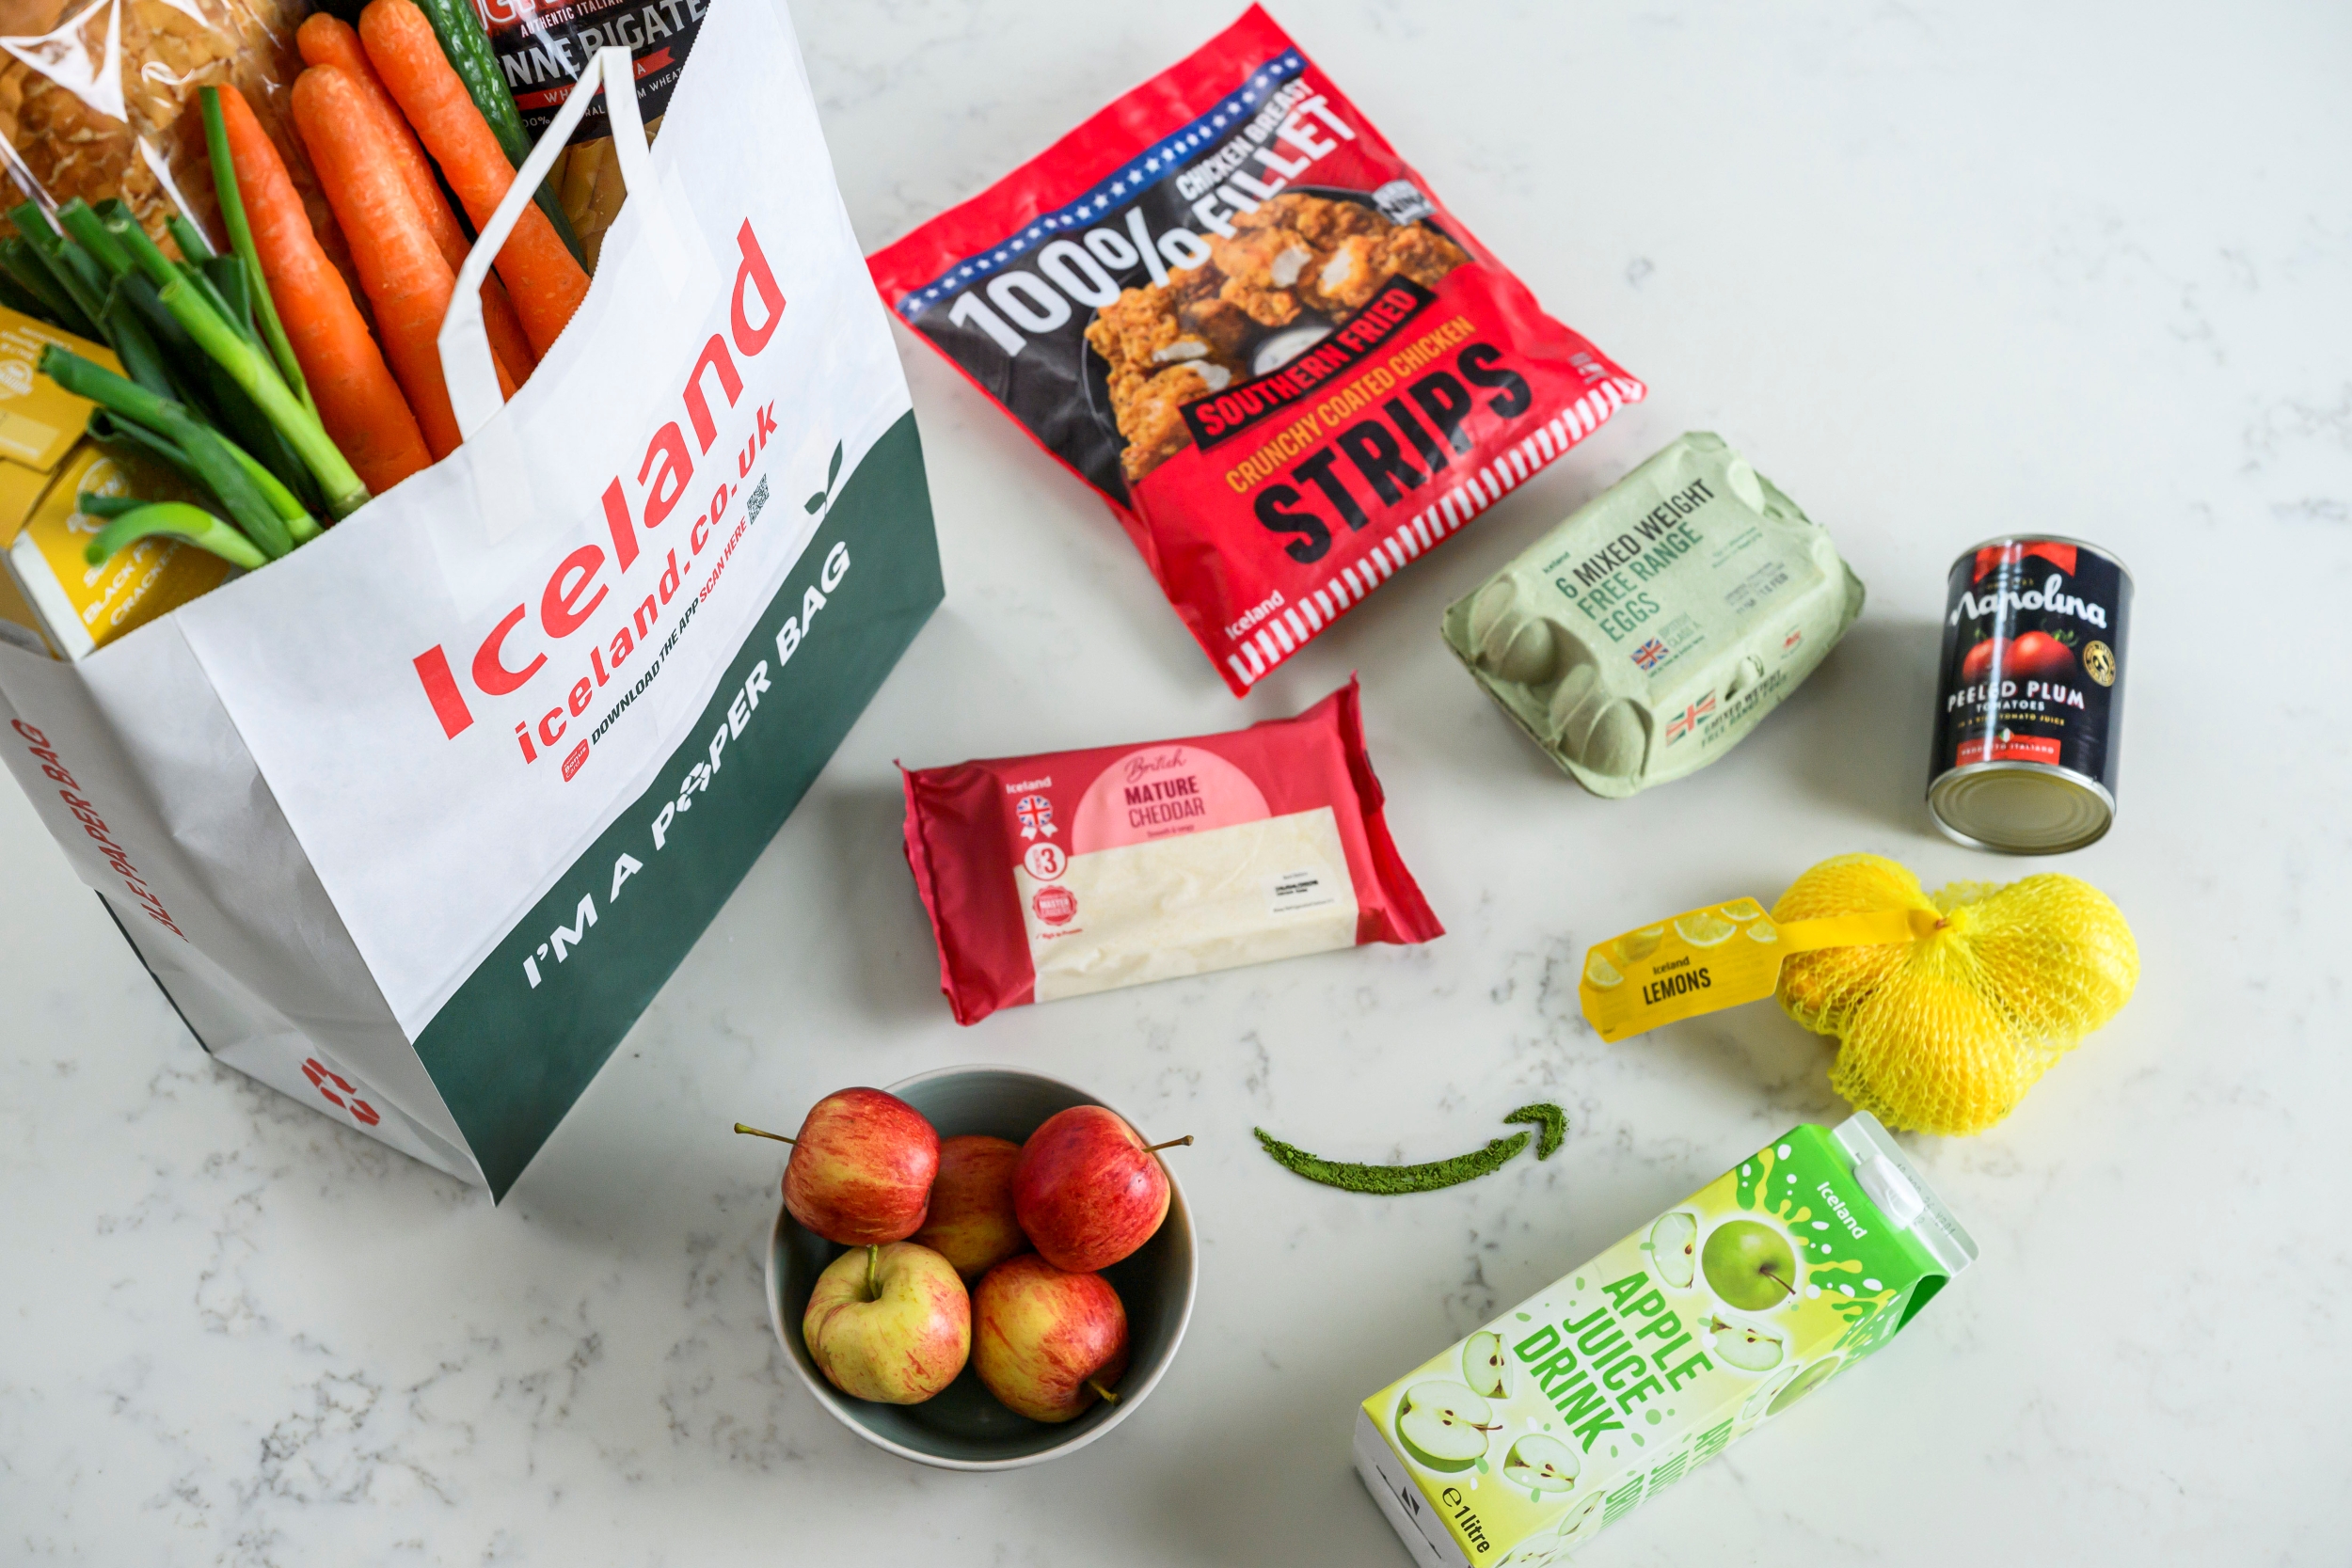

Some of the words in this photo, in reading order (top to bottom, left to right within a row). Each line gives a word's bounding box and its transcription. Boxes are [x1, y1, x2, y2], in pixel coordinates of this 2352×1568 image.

[520, 7, 575, 39] AUTHENTIC
[1176, 135, 1255, 201] CHICKEN
[1243, 76, 1315, 144] BREAST
[1191, 94, 1357, 240] FILLET
[947, 205, 1214, 358] 100%
[1194, 342, 1349, 438] SOUTHERN
[1338, 286, 1418, 355] FRIED
[1225, 411, 1324, 496] CRUNCHY
[1317, 365, 1397, 429] COATED
[1388, 314, 1476, 378] CHICKEN
[413, 216, 787, 741] Iceland
[1252, 341, 1534, 565] STRIPS
[515, 398, 778, 765] iceland.co.uk
[1555, 577, 1579, 600] 6
[1572, 532, 1642, 589] MIXED
[1634, 478, 1716, 544] WEIGHT
[1577, 568, 1638, 621] FREE
[1632, 520, 1704, 583] RANGE
[591, 663, 660, 746] DOWNLOAD
[659, 631, 678, 662] THE
[678, 596, 700, 635] APP
[699, 557, 724, 603] SCAN
[723, 515, 748, 563] HERE
[1225, 590, 1285, 641] Iceland
[1598, 591, 1661, 643] EGGS
[610, 851, 644, 904] A
[776, 540, 851, 667] BAG
[1947, 680, 2018, 713] PEELED
[2026, 680, 2085, 711] PLUM
[10, 718, 82, 792] BAG
[1006, 776, 1052, 794] Iceland
[1123, 774, 1200, 806] MATURE
[58, 788, 149, 887] PAPER
[1041, 847, 1057, 874] 3
[1128, 797, 1206, 829] CHEDDAR
[1643, 967, 1712, 1006] LEMONS
[1653, 956, 1691, 976] Iceland
[1817, 1180, 1868, 1241] Iceland
[1562, 1304, 1665, 1417] JUICE
[1601, 1271, 1714, 1395] APPLE
[1513, 1323, 1625, 1456] DRINK
[1460, 1513, 1490, 1554] litre
